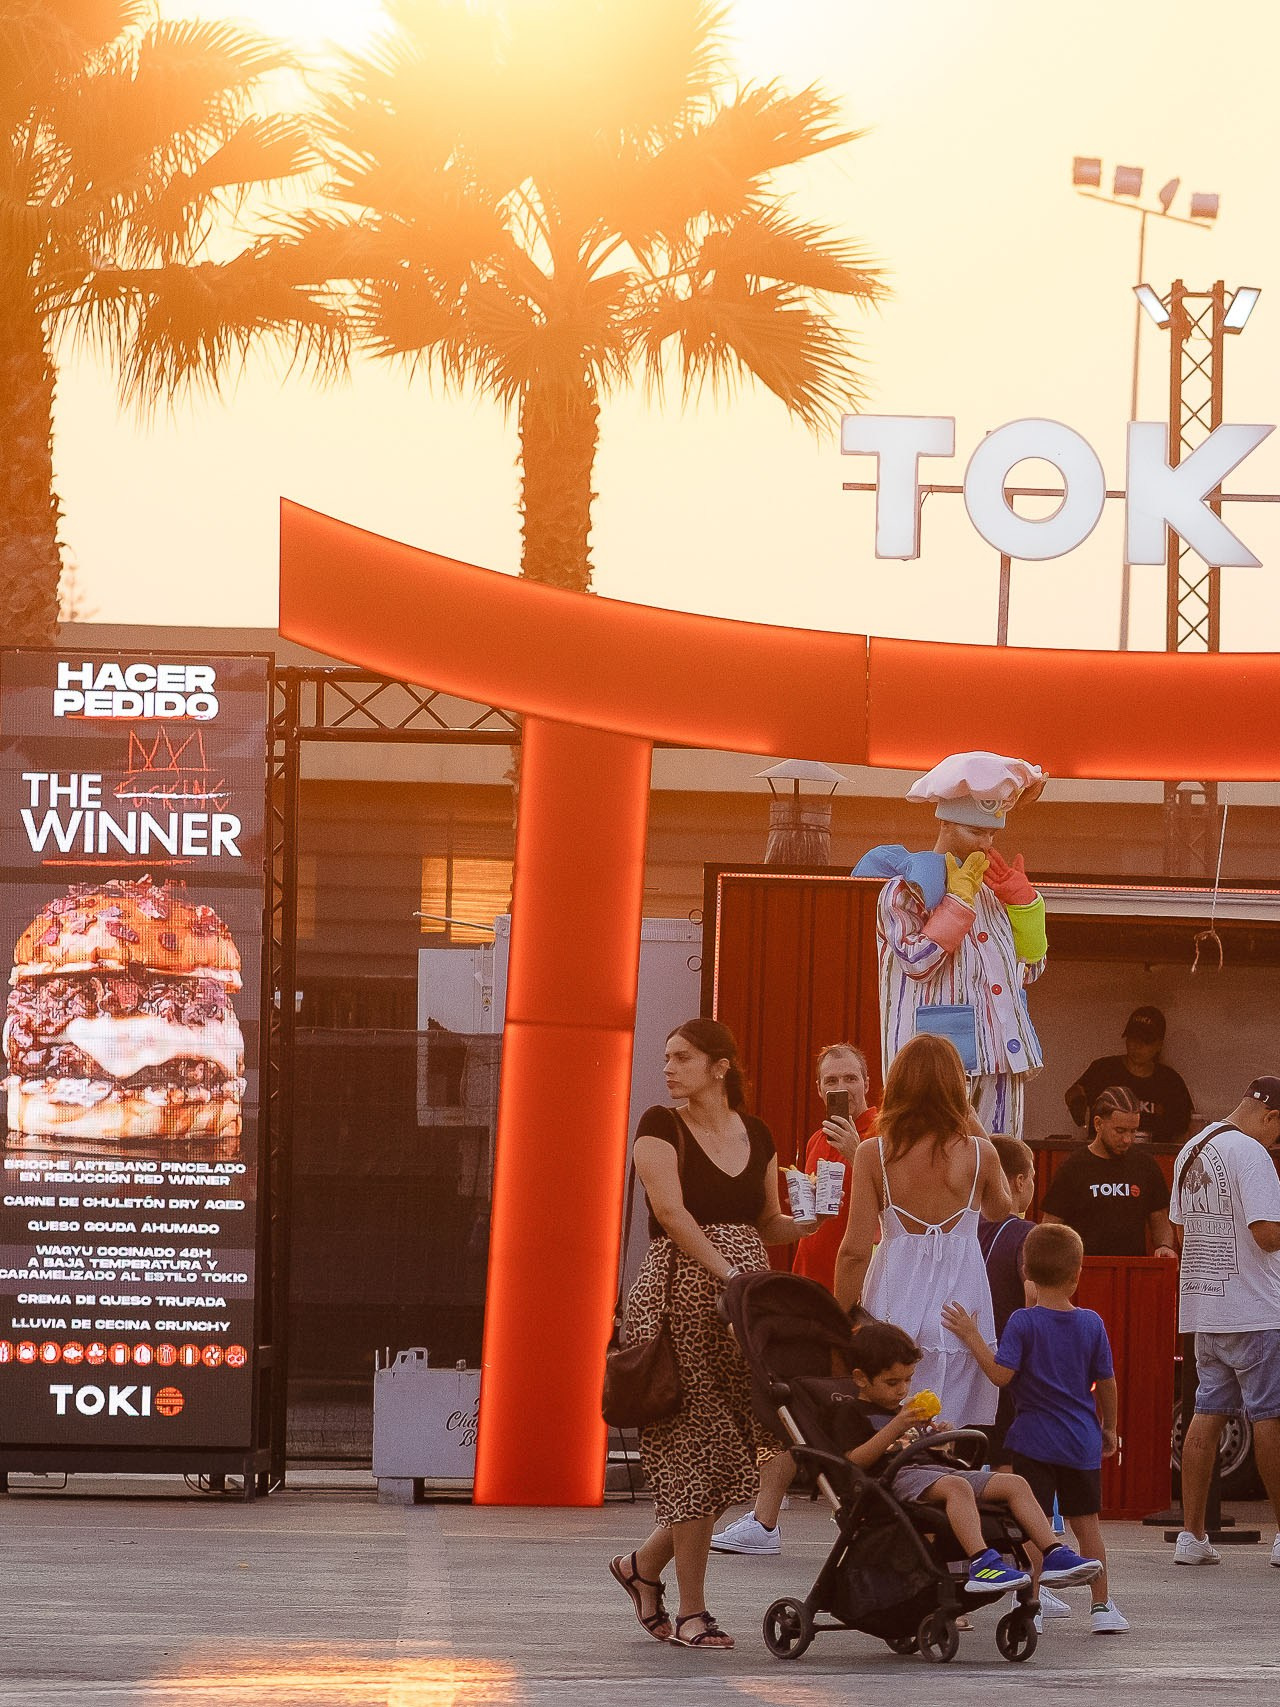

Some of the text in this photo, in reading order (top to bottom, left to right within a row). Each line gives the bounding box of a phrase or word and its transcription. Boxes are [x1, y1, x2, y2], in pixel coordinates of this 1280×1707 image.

[57, 662, 216, 692] HACER
[54, 689, 219, 720] PEDIDO
[22, 773, 102, 808] THE
[20, 809, 242, 856] WINNER
[4, 1160, 246, 1174] BRIOCHE ARTESANO PINCELADO
[20, 1171, 230, 1186] EN REDUCCIÓN RED WINNER
[1212, 1156, 1227, 1194] FLORIDA
[4, 1196, 245, 1210] CARNE DE CHULETÓN DRY AGED
[28, 1221, 220, 1234] QUESO GOUDA AHUMADO
[36, 1245, 211, 1258] WAGYU COCINADO 48H
[28, 1257, 218, 1270] A BAJA TEMPERATURA Y
[0, 1269, 248, 1283] CARAMELIZADO AL ESTILO TOKIO
[17, 1294, 227, 1307] CREMA DE QUESO TRUFADA
[12, 1318, 230, 1332] LLUVIA DE CECINA CRUNCHY
[446, 1411, 478, 1431] Cha
